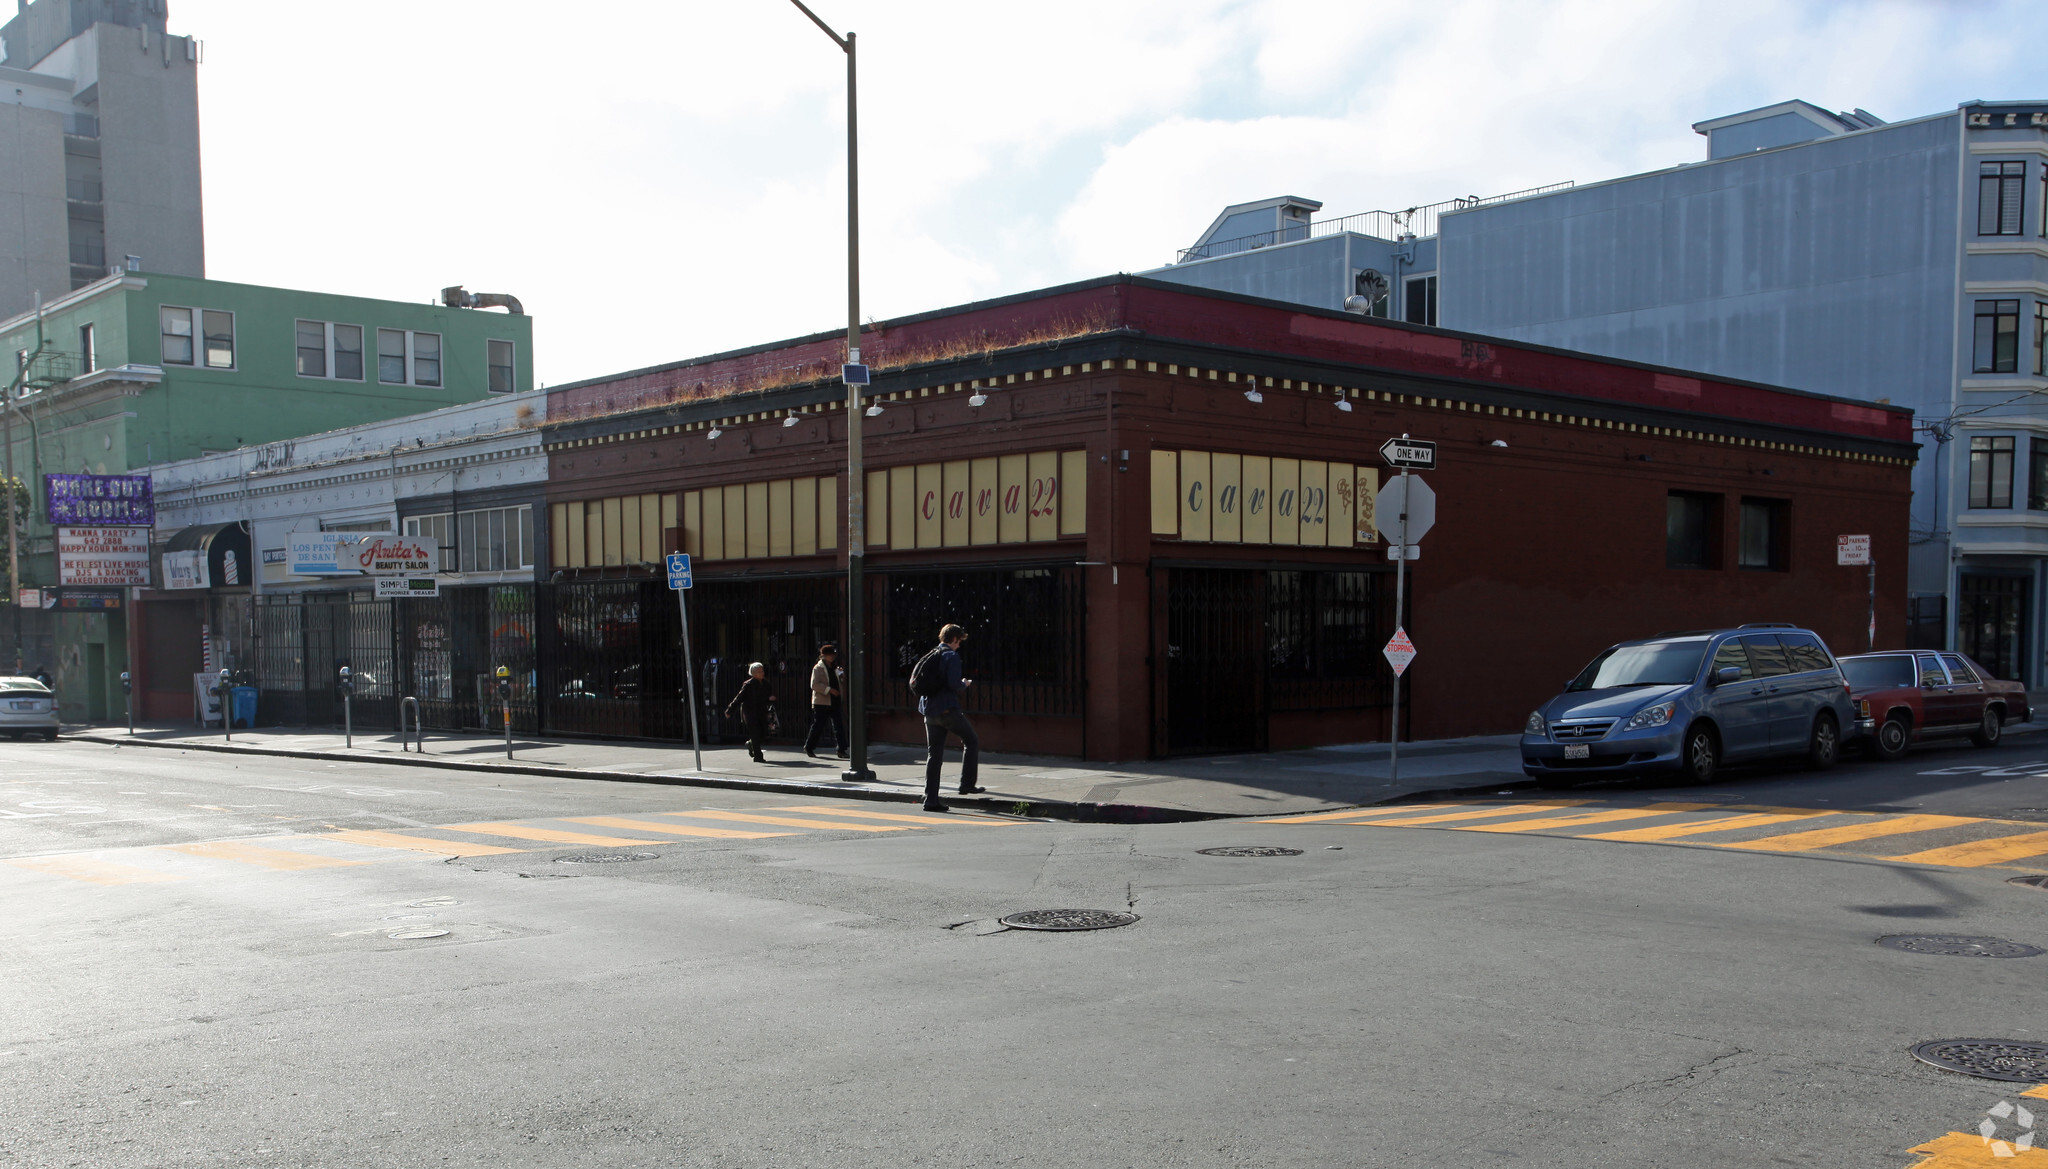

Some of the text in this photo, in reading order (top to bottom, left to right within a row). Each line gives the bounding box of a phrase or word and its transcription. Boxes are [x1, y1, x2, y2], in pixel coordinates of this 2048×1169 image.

[1397, 448, 1431, 461] ONE WAY
[52, 479, 145, 498] MAKE OUT
[76, 500, 130, 518] ROOM
[60, 545, 88, 553] HAPPY
[293, 544, 311, 552] LOS
[298, 553, 310, 561] DE
[312, 553, 330, 561] SAN
[360, 539, 429, 568] Anita's
[375, 561, 430, 570] BEAUTY SALON
[66, 577, 145, 585] MAKEOUTROOM COM
[380, 581, 435, 589] SIMPLE Mobile
[674, 579, 687, 587] ONLY
[1396, 631, 1406, 639] NO
[1386, 643, 1414, 653] STOPPING
